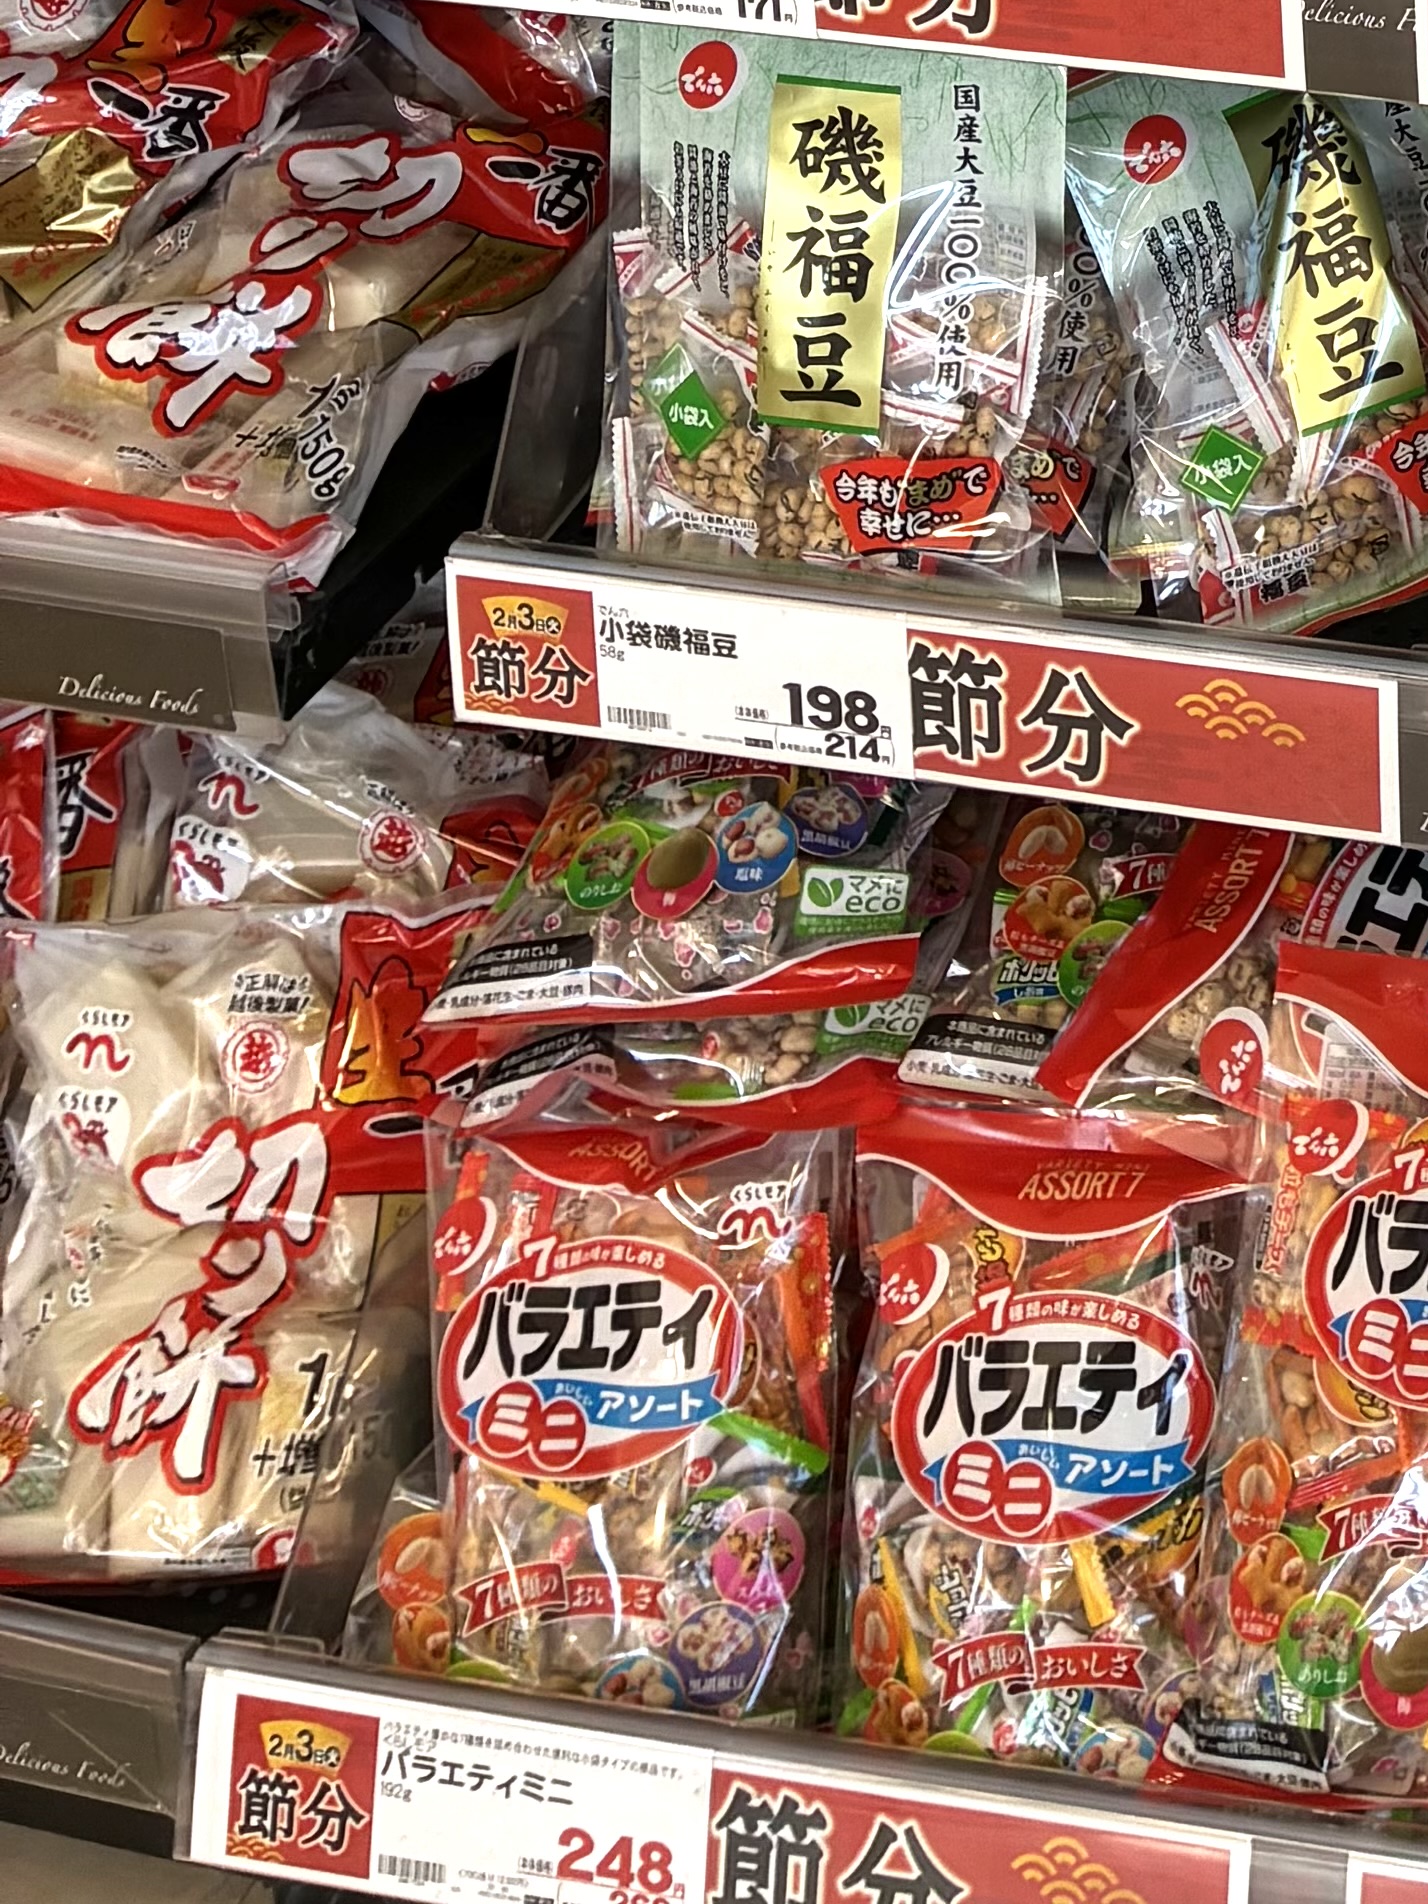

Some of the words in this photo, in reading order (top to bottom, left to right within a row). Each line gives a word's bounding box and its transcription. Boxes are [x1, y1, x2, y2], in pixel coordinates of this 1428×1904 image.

[780, 105, 889, 409] 磯福豆
[668, 402, 716, 431] 小袋入
[599, 618, 739, 660] 小袋磯福豆
[600, 645, 624, 663] 58g
[58, 676, 143, 707] Delicious
[148, 687, 202, 716] Foods
[923, 1337, 1190, 1439] バラエティ
[1065, 1451, 1175, 1490] アソート
[1040, 1650, 1133, 1680] おいしさ
[380, 1753, 575, 1808] バラエティミニ
[380, 1780, 411, 1804] 192g
